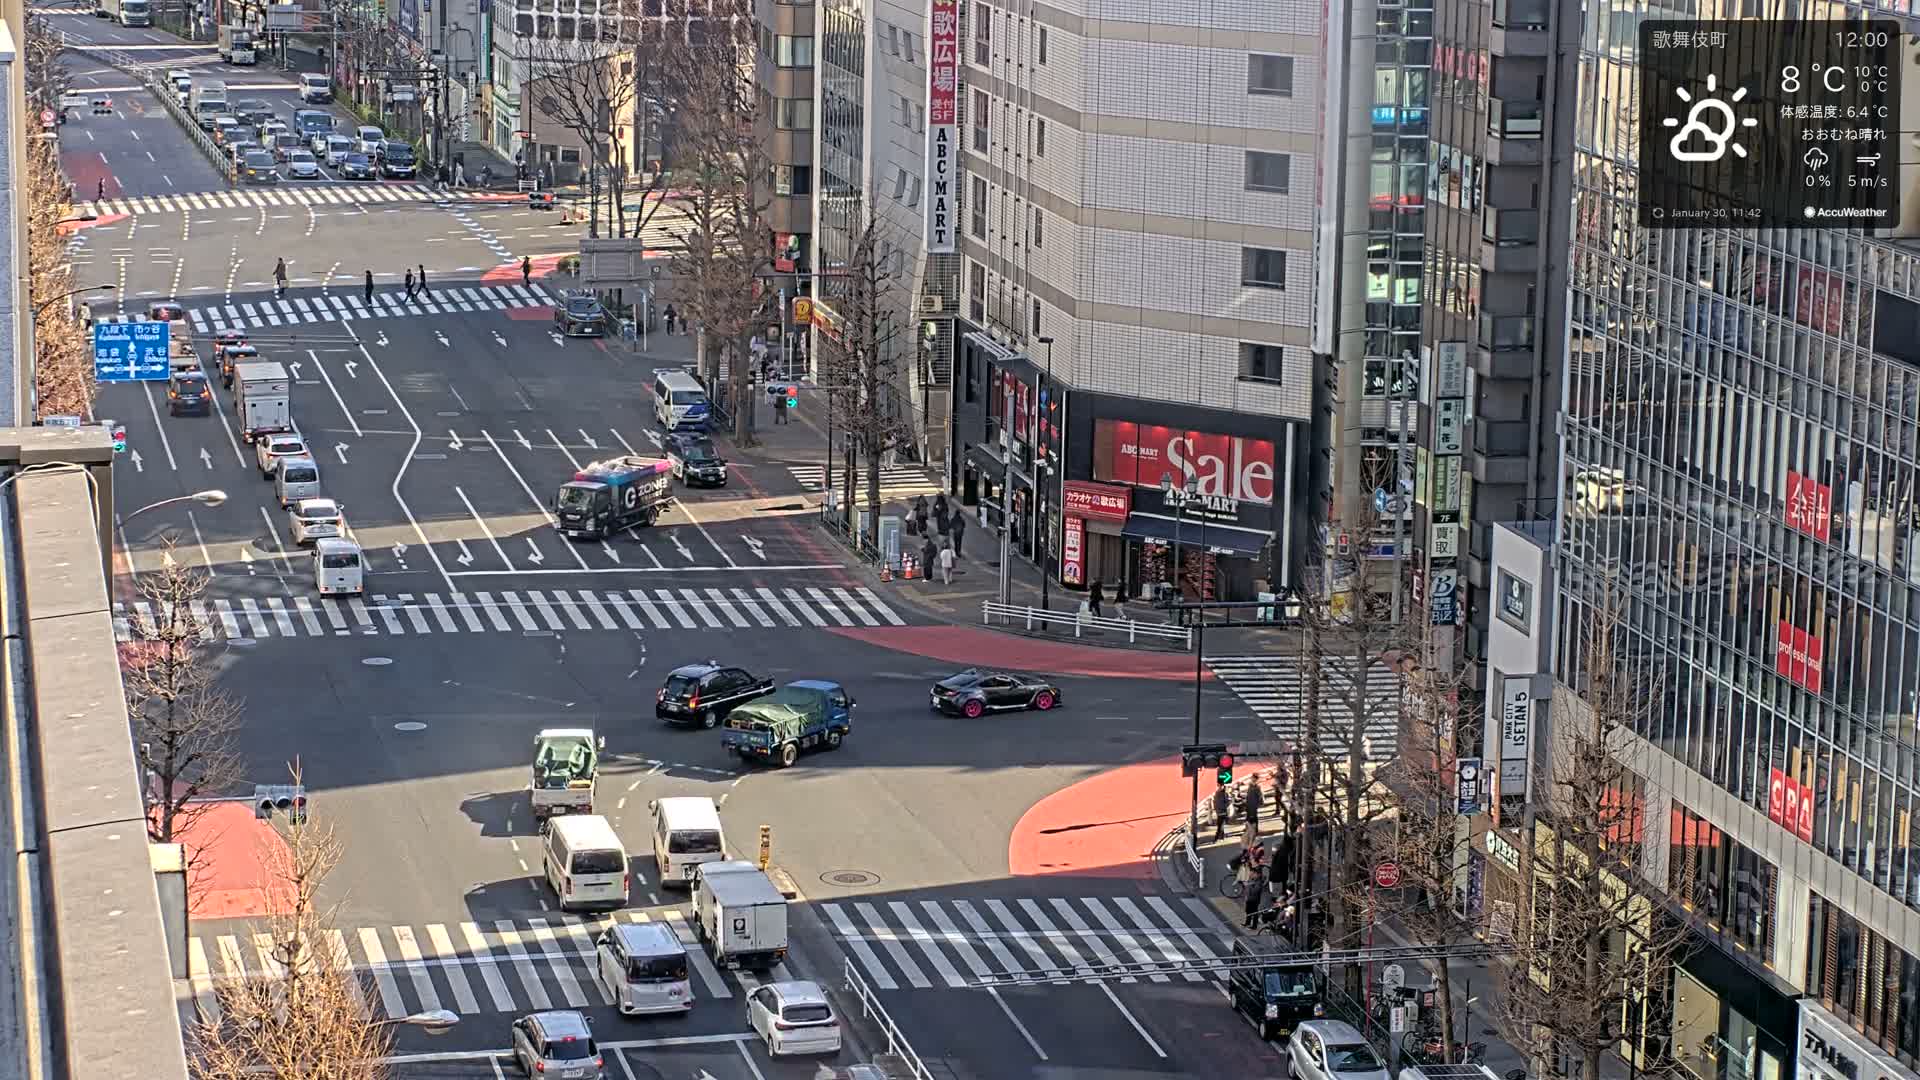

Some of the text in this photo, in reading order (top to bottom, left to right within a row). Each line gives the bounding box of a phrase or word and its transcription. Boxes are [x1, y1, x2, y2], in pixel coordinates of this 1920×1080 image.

[933, 10, 955, 92] 歌広場
[932, 110, 953, 121] 5F
[1121, 444, 1159, 458] ABCMART
[1167, 436, 1273, 502] Sale
[1066, 491, 1092, 504] カラオケ
[1440, 514, 1451, 522] 7F
[1791, 483, 1828, 531] 会計
[1504, 702, 1514, 740] PARK CITY
[1513, 691, 1528, 747] ISETAN 5
[1772, 780, 1810, 829] CPA
